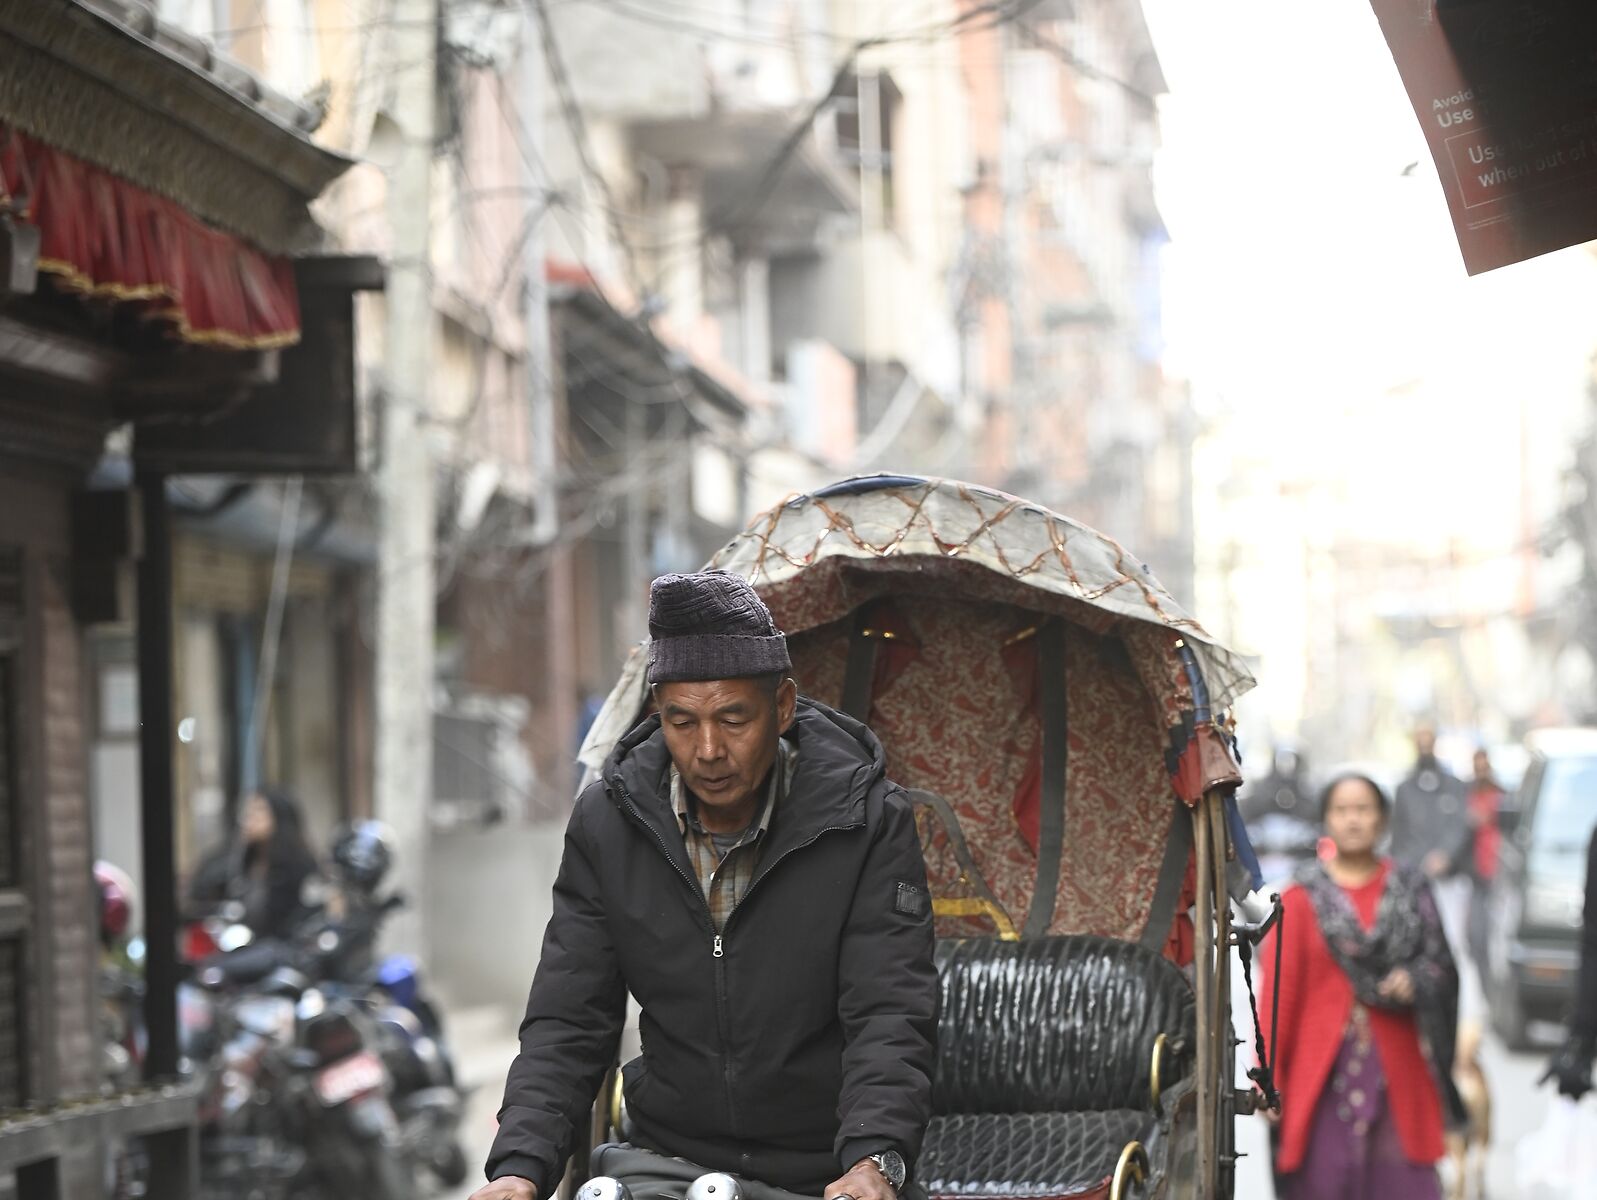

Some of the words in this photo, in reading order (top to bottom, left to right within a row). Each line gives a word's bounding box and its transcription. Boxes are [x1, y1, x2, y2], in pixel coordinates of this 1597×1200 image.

[1432, 88, 1474, 111] Avoid
[1436, 108, 1474, 128] Use
[1468, 145, 1506, 164] Use
[1478, 163, 1530, 188] when
[1535, 149, 1566, 171] out
[1569, 140, 1588, 160] of
